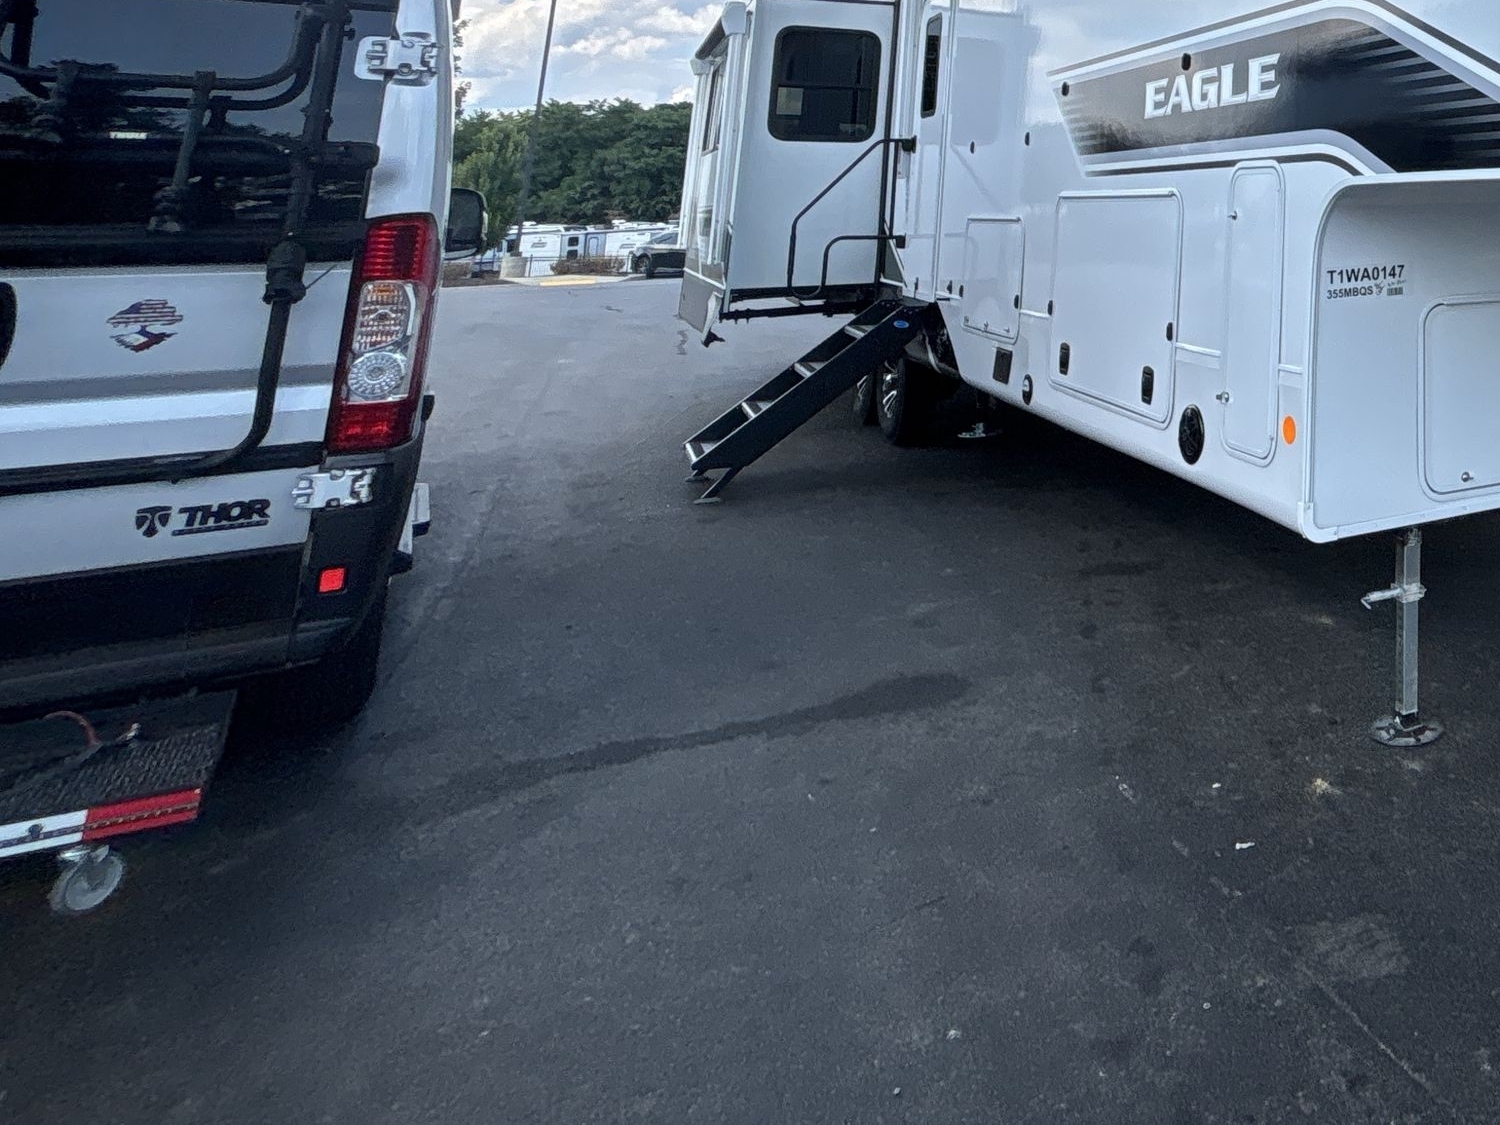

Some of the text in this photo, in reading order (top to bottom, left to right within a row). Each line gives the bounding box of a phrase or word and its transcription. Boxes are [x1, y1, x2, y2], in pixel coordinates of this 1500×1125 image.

[1143, 52, 1281, 120] EAGLE
[1326, 264, 1406, 285] T1WA0147
[1326, 284, 1374, 299] 355MBQS
[178, 499, 272, 528] THOR
